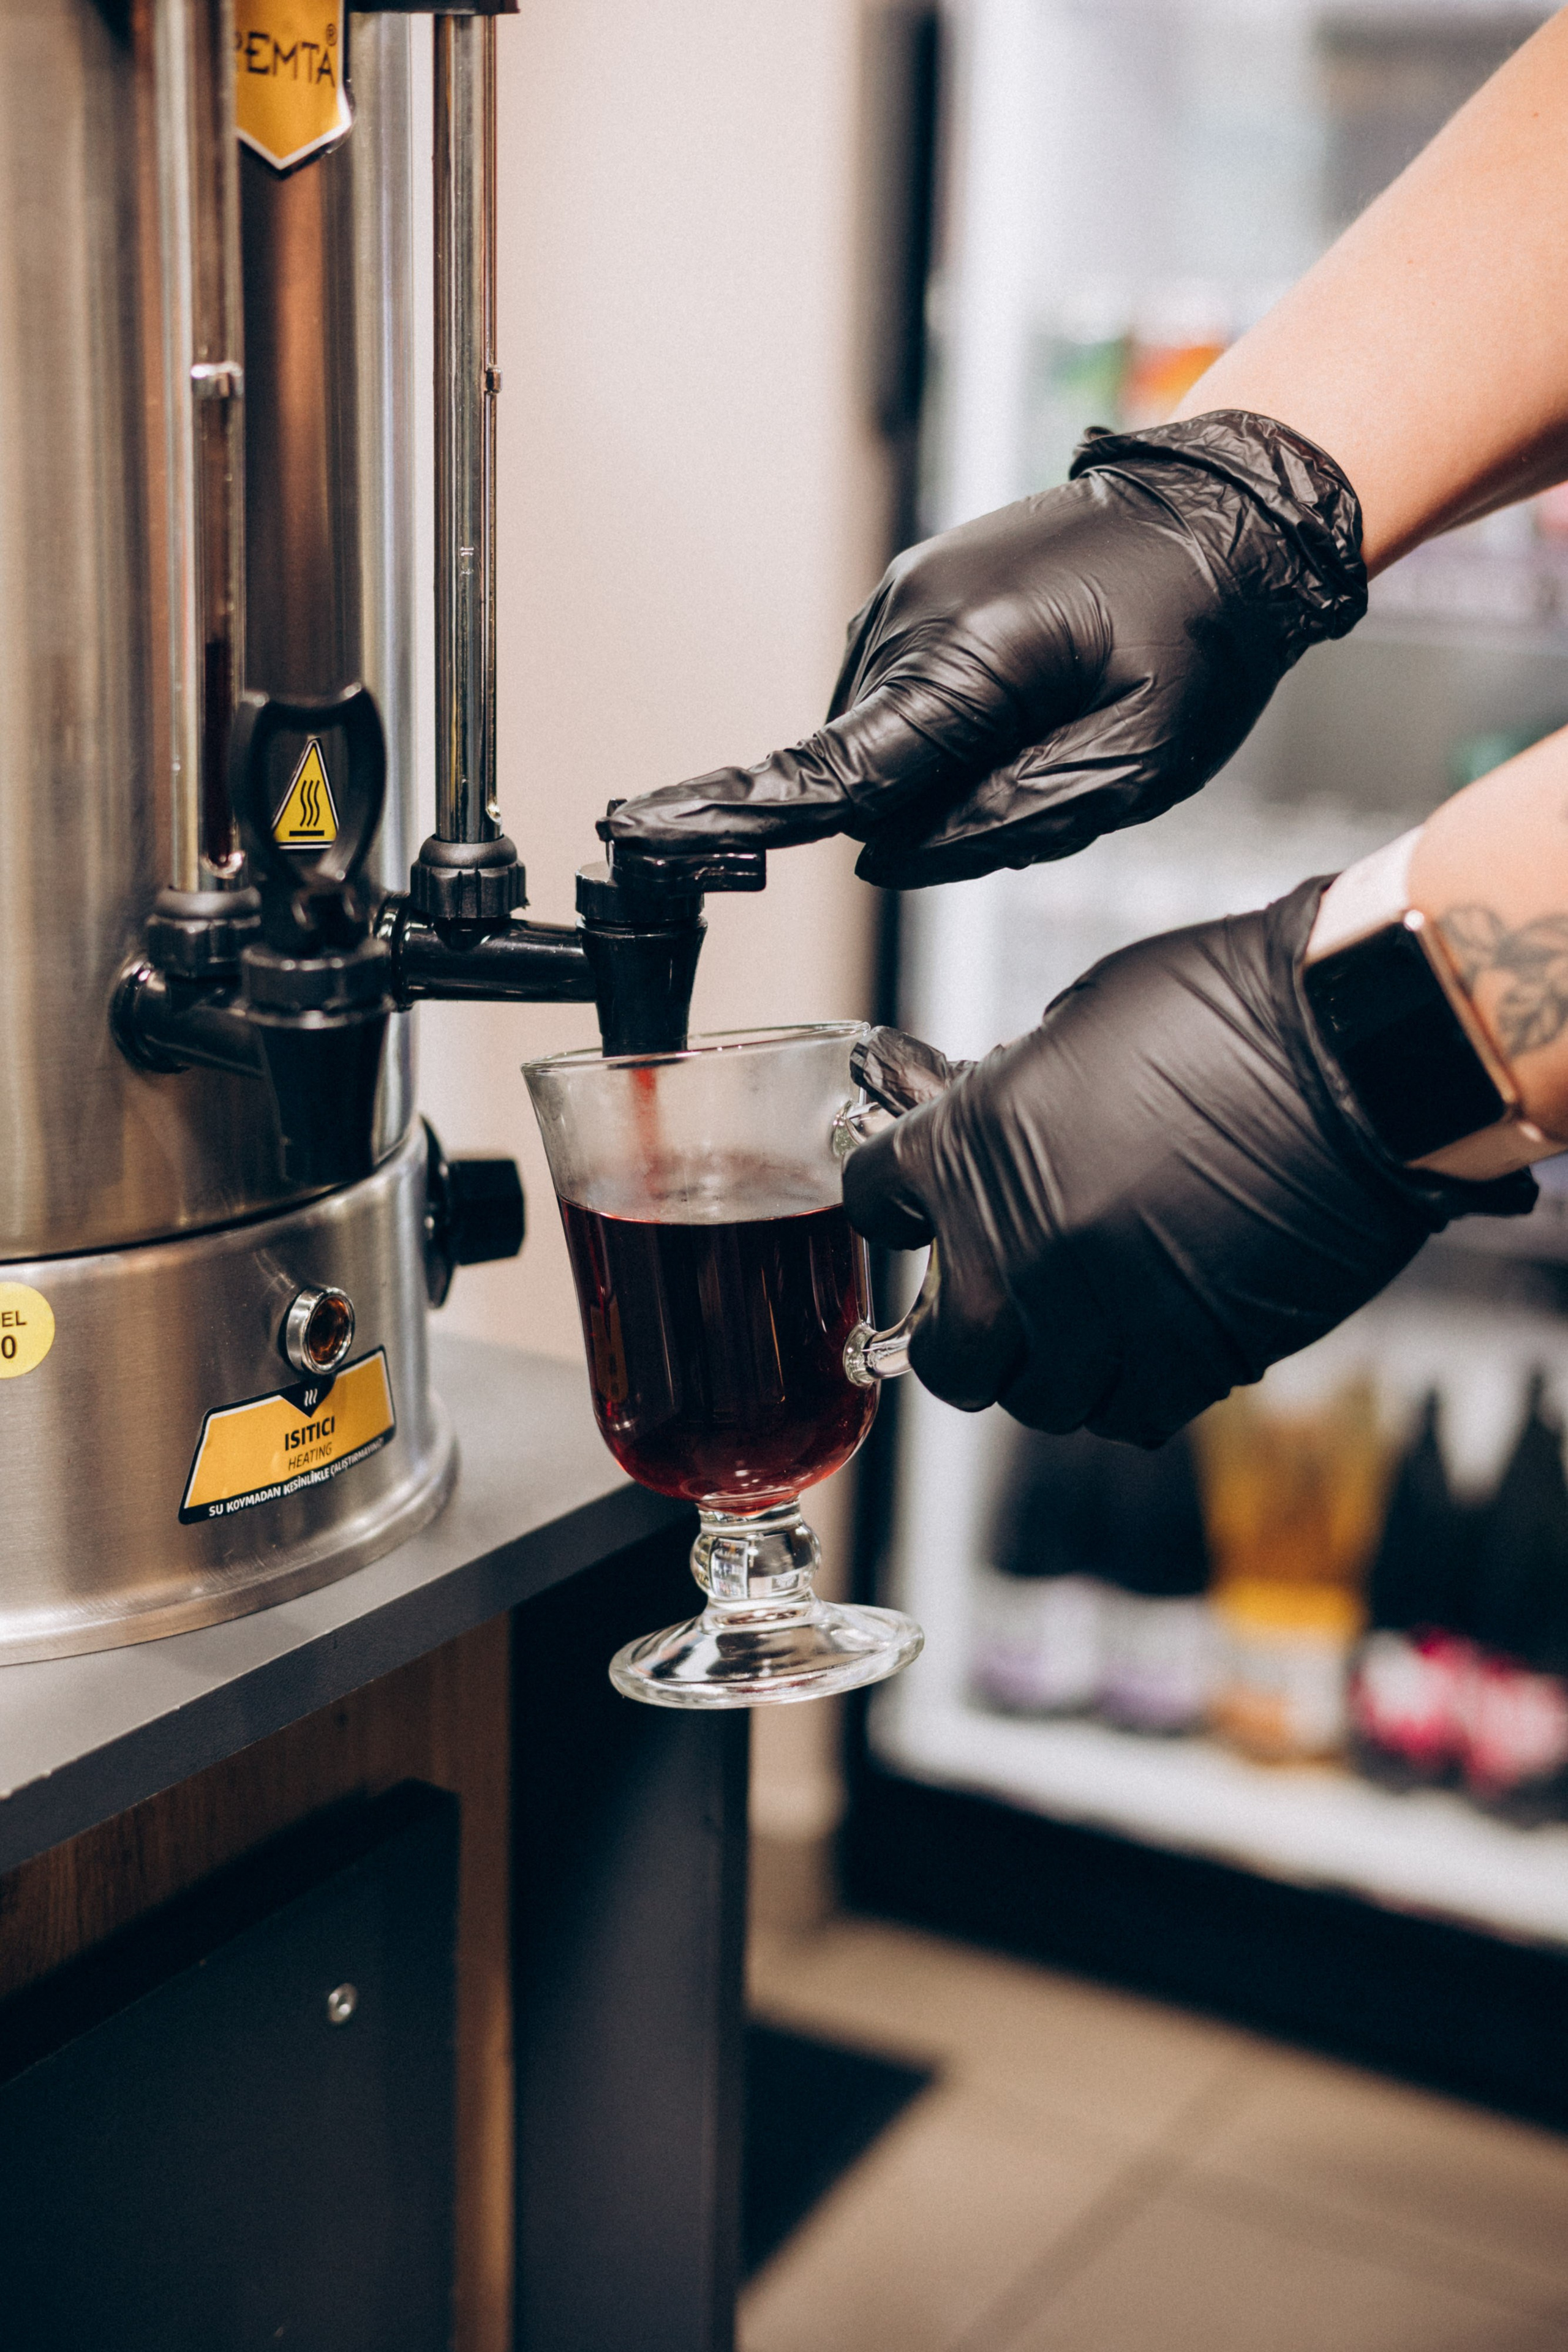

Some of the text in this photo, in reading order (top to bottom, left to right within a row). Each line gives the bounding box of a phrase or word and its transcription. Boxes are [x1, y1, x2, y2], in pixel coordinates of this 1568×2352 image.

[235, 31, 335, 88] EMTA
[0, 1310, 27, 1327] EL
[284, 1415, 336, 1451] ISITICI
[288, 1442, 332, 1471] HEATING
[209, 1504, 224, 1517] SU
[226, 1485, 282, 1513] KOYMADAN
[283, 1468, 330, 1495] KESİNLİKLE
